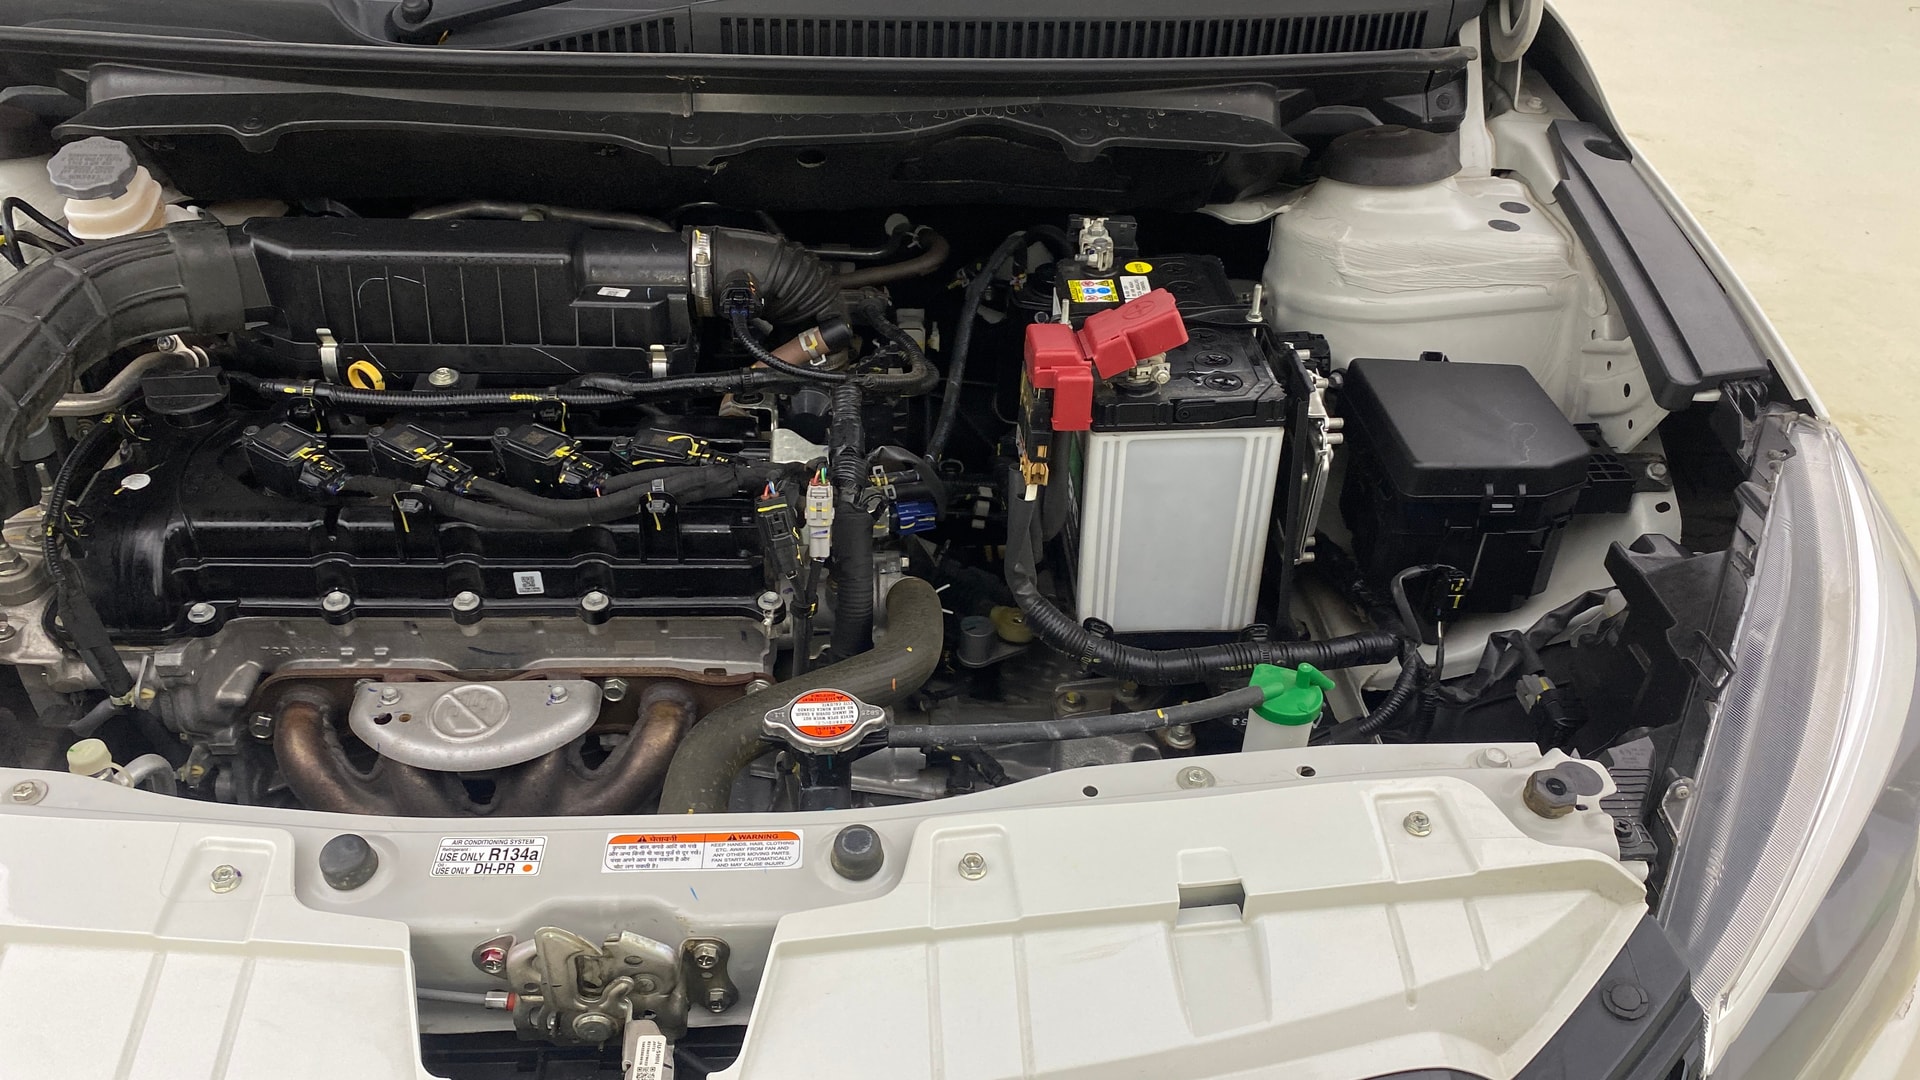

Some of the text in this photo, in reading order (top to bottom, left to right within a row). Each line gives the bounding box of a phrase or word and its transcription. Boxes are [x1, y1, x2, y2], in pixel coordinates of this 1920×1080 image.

[440, 848, 539, 861] USE ONLY R134a
[474, 863, 515, 874] DH-PR
